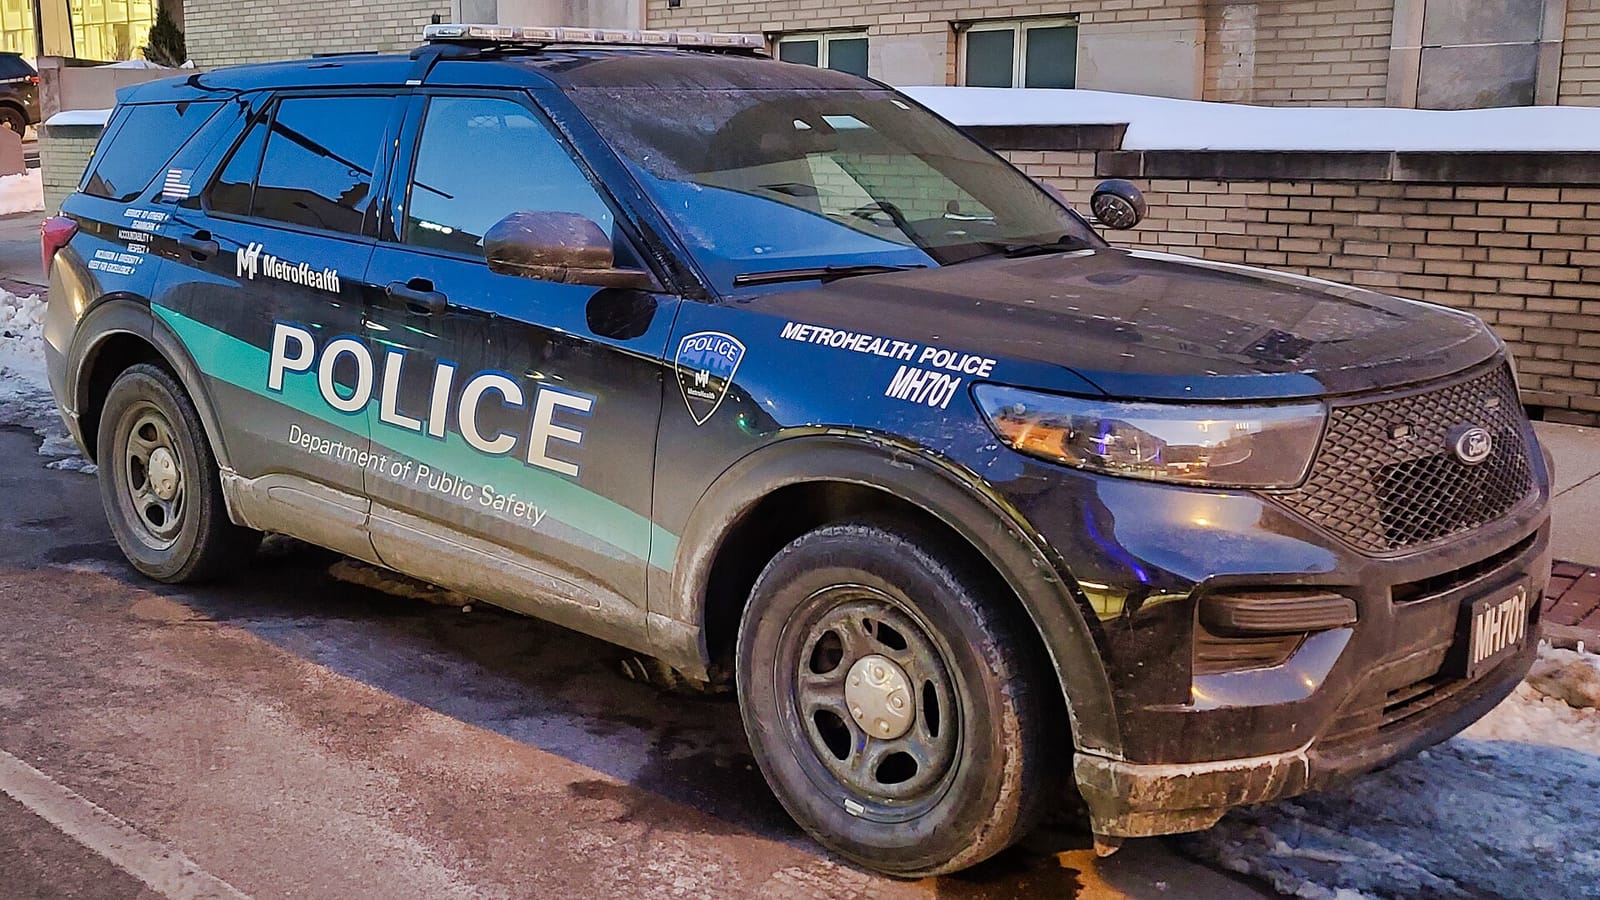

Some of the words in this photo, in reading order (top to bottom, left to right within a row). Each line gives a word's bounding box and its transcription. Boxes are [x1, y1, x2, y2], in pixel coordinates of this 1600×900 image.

[263, 254, 340, 293] MetroHealth
[683, 337, 738, 361] POLICE
[780, 322, 918, 361] METROHEALTH
[918, 346, 996, 378] POLICE
[266, 321, 596, 478] POLICE
[884, 365, 962, 410] MH701
[288, 424, 388, 474] Department
[390, 460, 412, 478] of
[414, 465, 474, 501] Public
[479, 485, 547, 527] Safety
[1474, 591, 1528, 664] MH701
